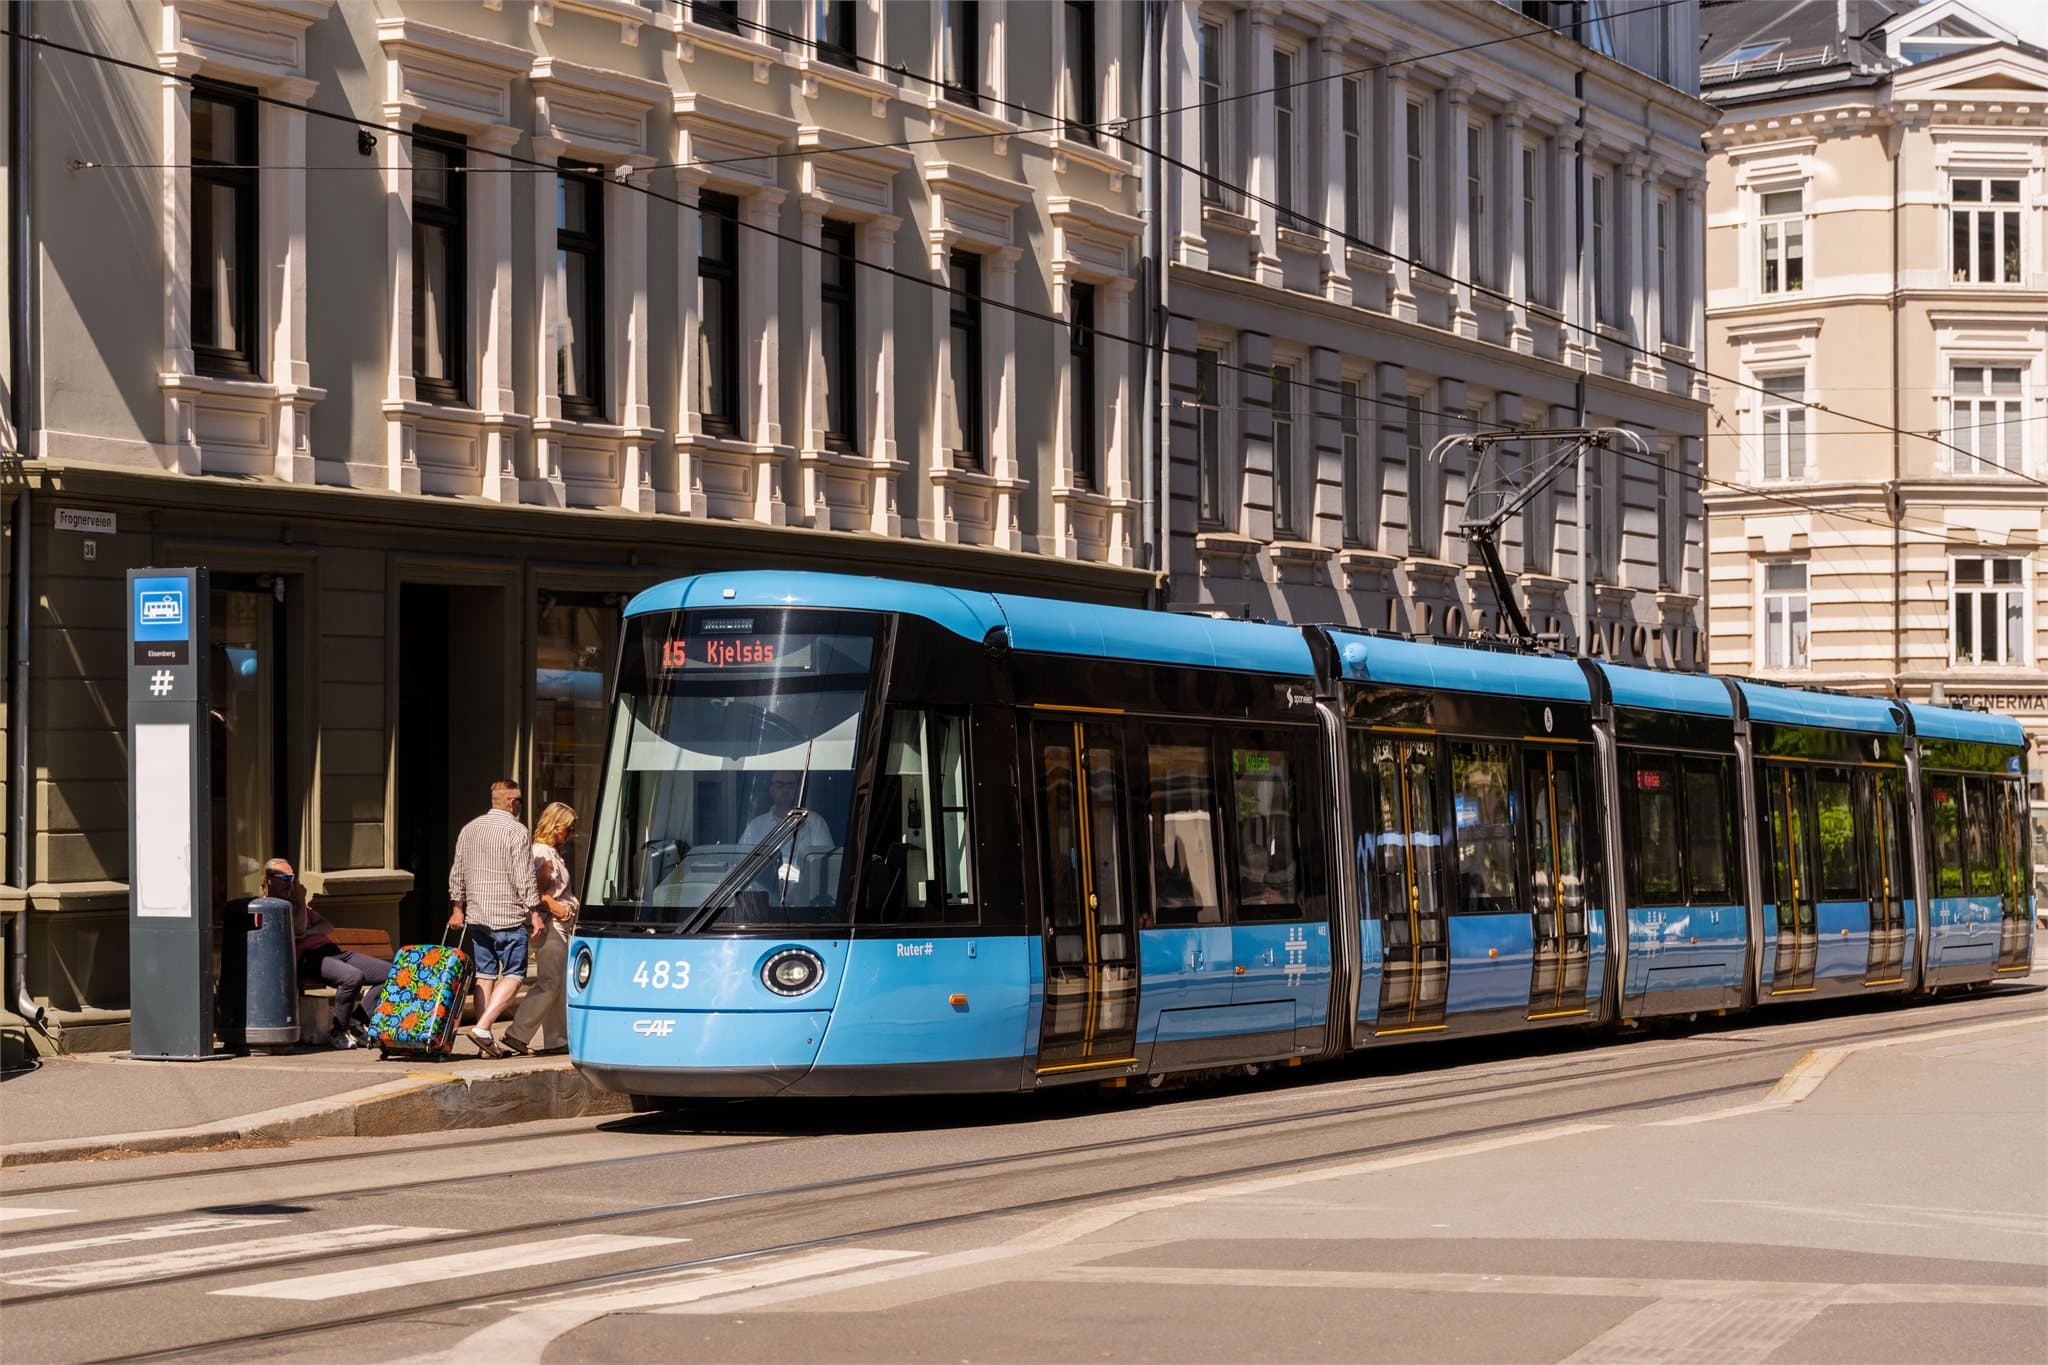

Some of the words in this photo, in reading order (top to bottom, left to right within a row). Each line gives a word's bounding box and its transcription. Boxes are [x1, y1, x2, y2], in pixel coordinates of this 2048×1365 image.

[60, 511, 112, 528] Frognerveien
[663, 640, 686, 667] 15
[707, 640, 774, 668] Kjelsås
[1945, 693, 2048, 710] OGNERMA
[896, 942, 934, 957] Ruter#
[632, 960, 690, 990] 483
[633, 1019, 676, 1037] CAF
